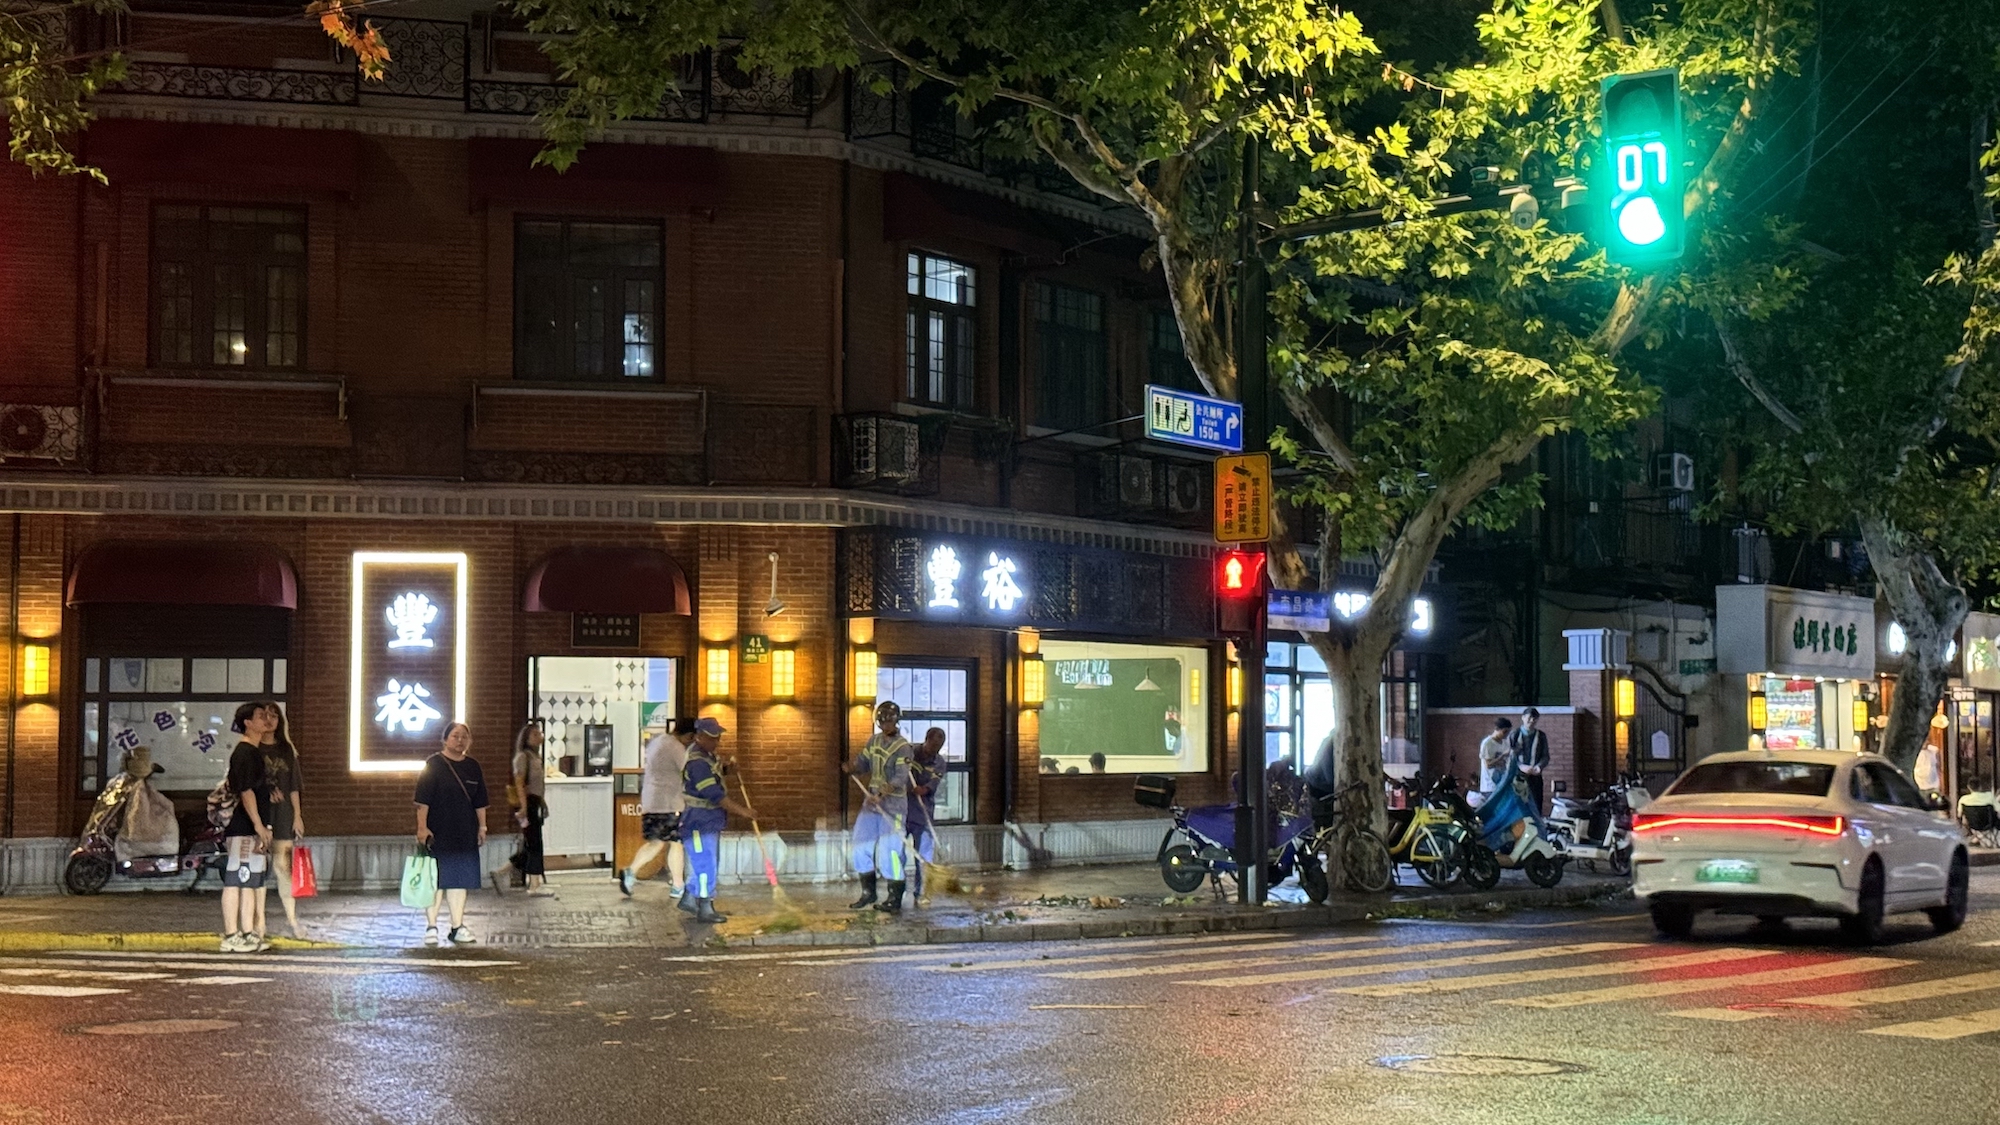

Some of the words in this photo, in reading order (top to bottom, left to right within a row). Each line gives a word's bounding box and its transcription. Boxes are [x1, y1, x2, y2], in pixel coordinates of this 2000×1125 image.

[1617, 142, 1667, 191] 07
[1199, 425, 1220, 441] 150m
[1252, 477, 1261, 536] 禁止违法停车
[749, 637, 762, 648] 41
